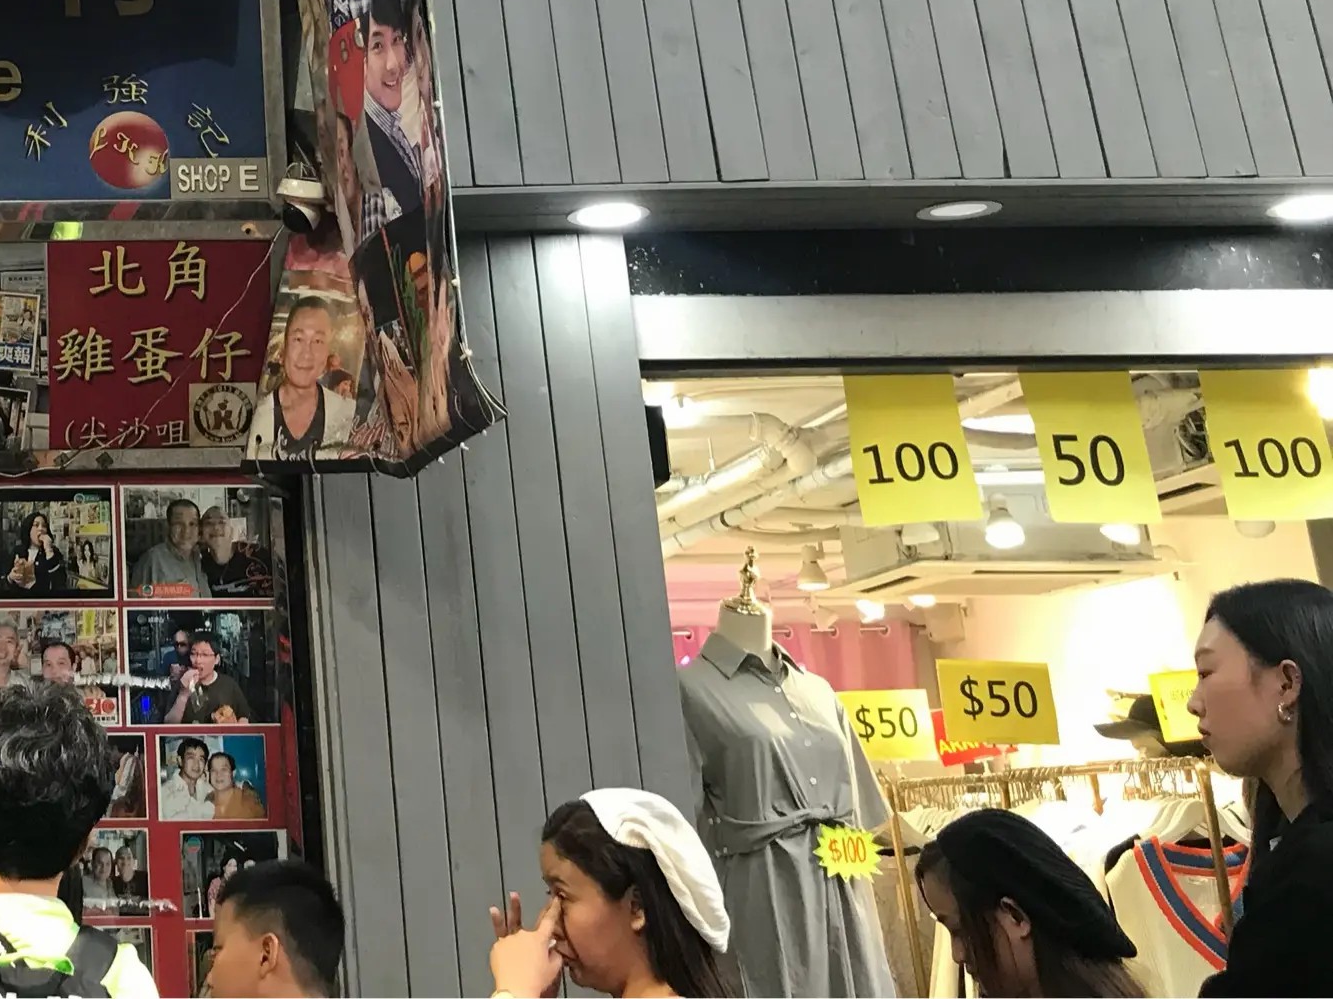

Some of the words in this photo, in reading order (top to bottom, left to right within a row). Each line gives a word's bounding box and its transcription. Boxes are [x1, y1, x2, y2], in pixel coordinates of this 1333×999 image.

[177, 164, 231, 193] SHOP
[239, 164, 260, 191] E
[89, 241, 207, 301] 北角
[53, 326, 252, 384] 雞蛋仔
[862, 440, 959, 485] 100
[1052, 433, 1127, 488] 50
[1224, 436, 1322, 479] 100
[958, 675, 1039, 721] $50
[855, 704, 918, 743] $50
[828, 836, 867, 863] $100
